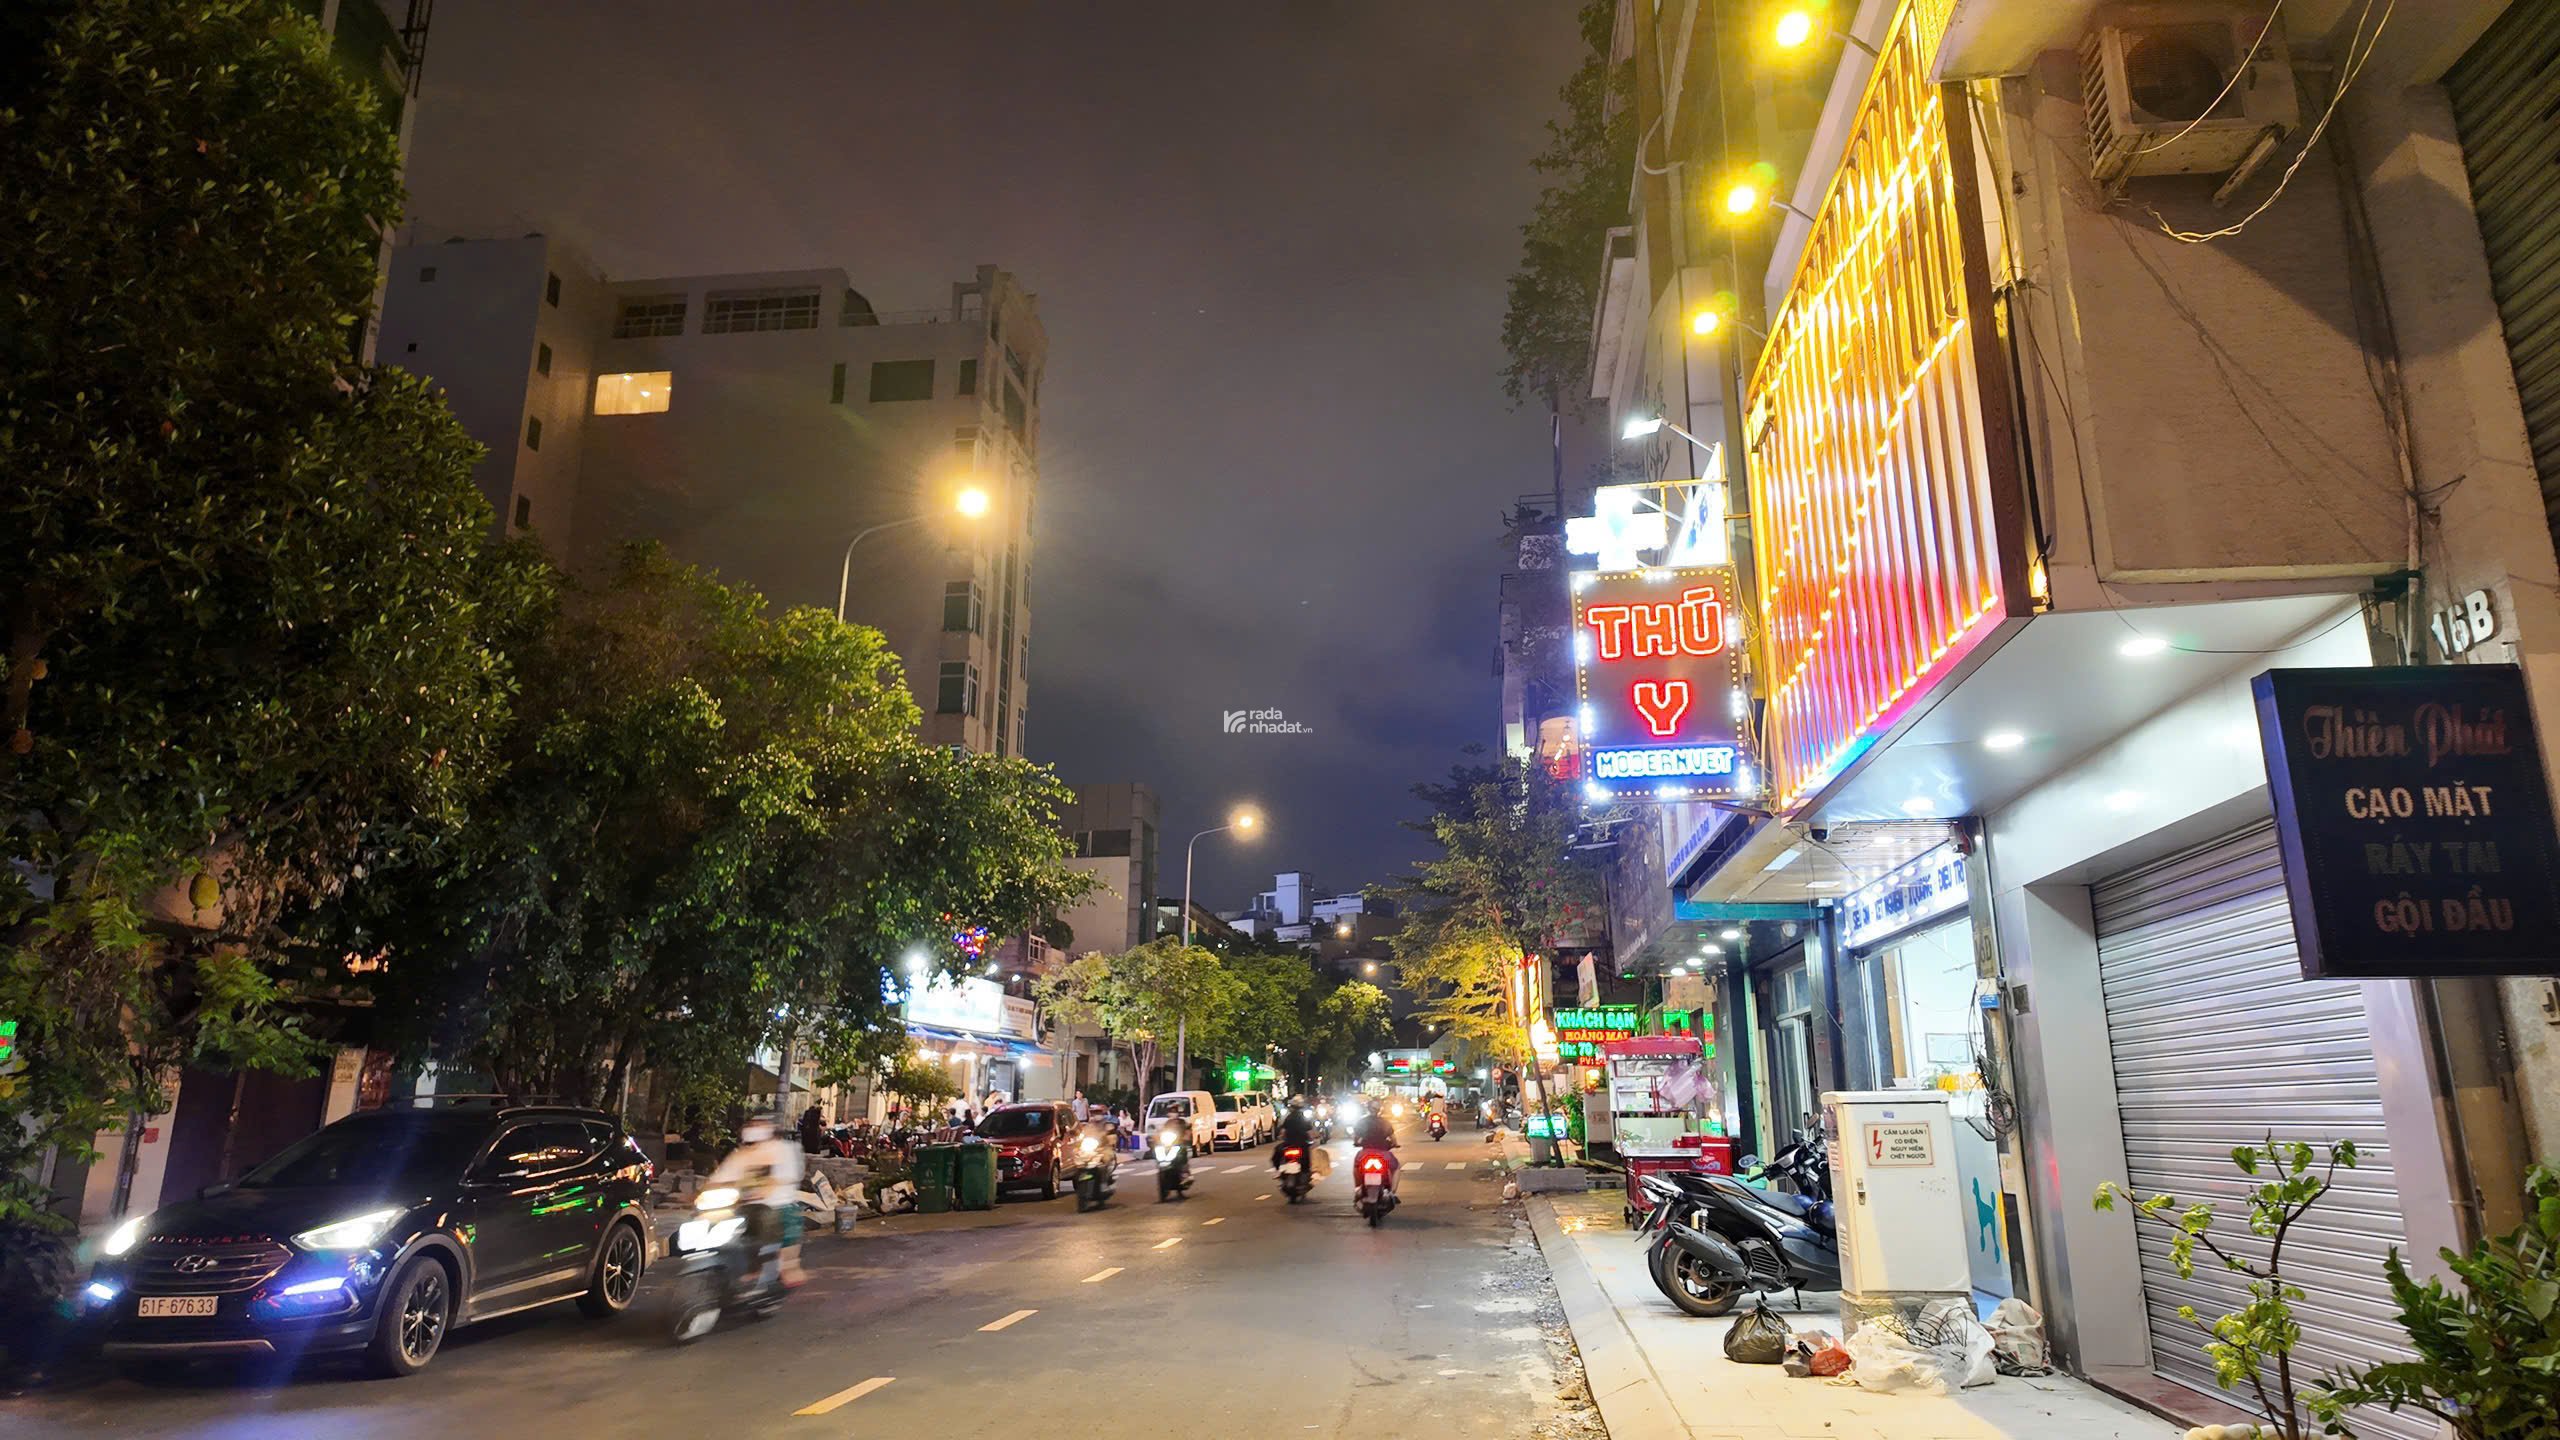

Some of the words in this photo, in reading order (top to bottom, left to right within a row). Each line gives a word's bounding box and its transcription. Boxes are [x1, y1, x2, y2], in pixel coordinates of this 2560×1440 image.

[1587, 587, 1724, 659] THÚ
[2431, 589, 2495, 656] 16B
[1634, 681, 1689, 736] Y
[1596, 747, 1734, 779] MODERNVET
[2344, 786, 2415, 825] CẠO
[2422, 780, 2493, 826] MẶT
[2364, 833, 2433, 875] RÁY
[2374, 890, 2433, 938] GỘI
[2442, 884, 2514, 932] ĐẦU
[1557, 1008, 1604, 1028] KHÁCH
